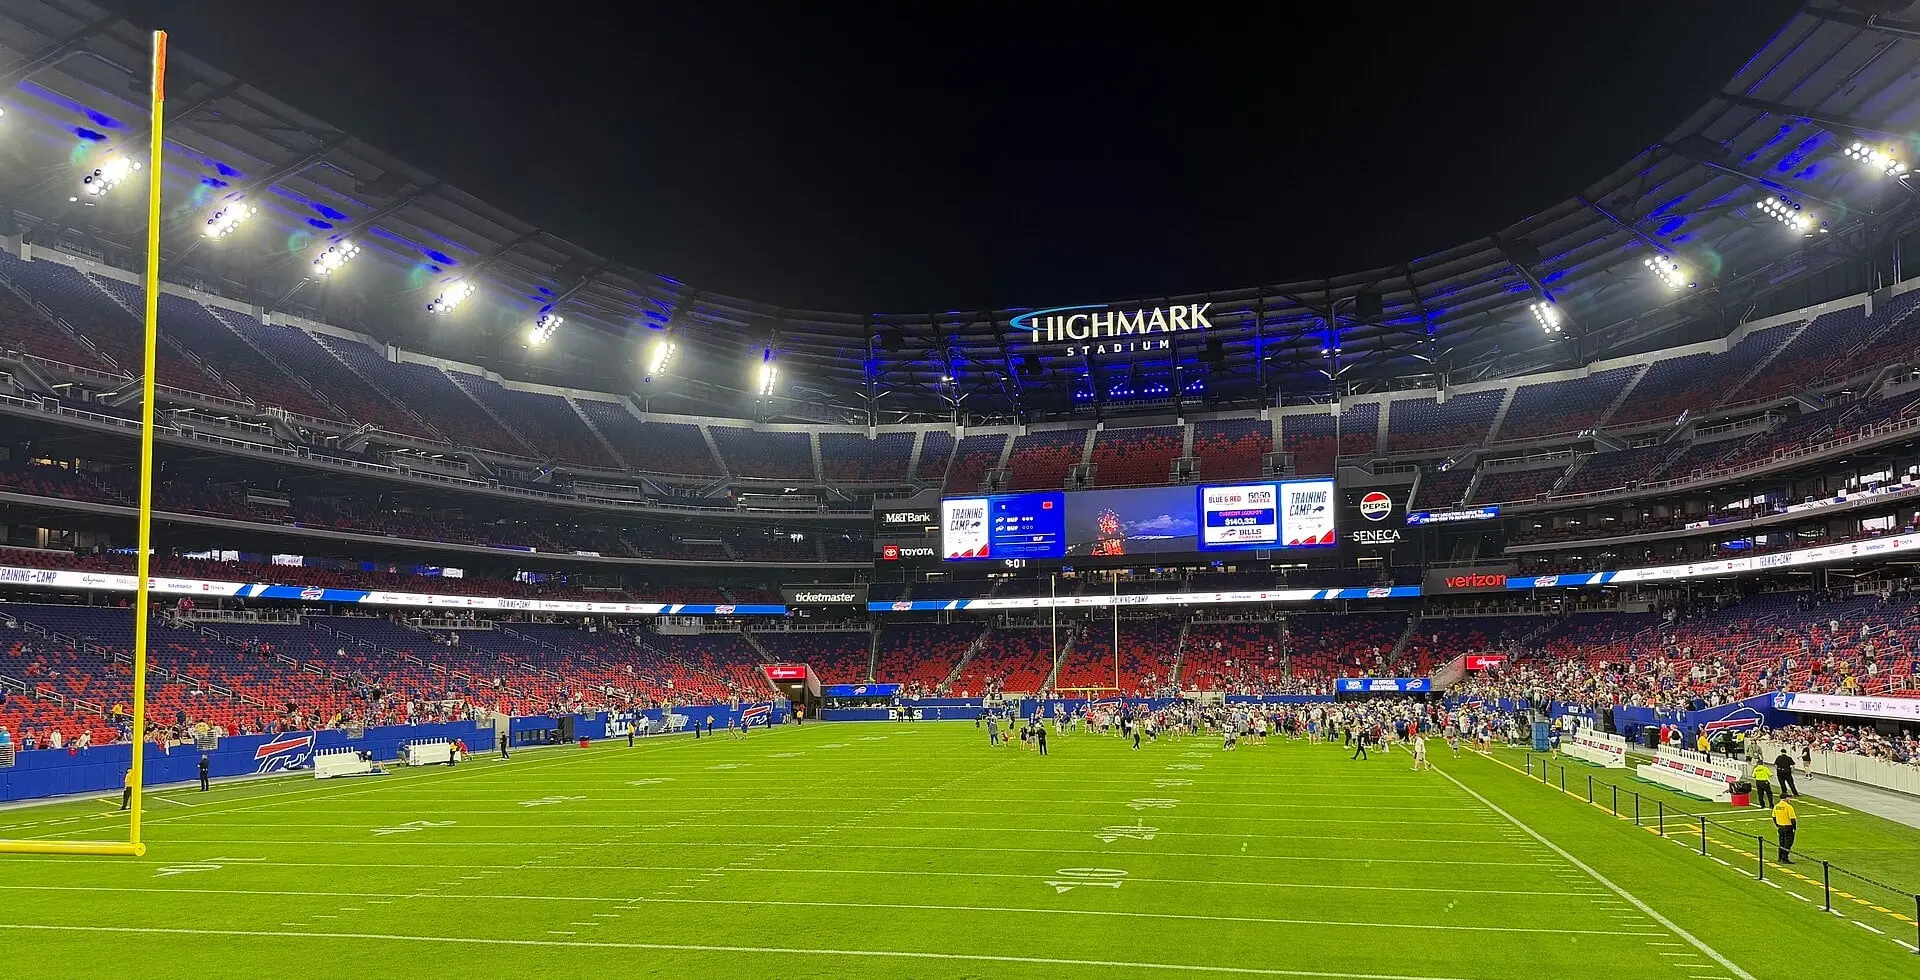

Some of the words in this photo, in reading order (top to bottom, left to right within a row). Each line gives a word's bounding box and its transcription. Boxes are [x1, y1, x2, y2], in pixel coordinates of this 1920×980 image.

[1031, 302, 1213, 343] HIGHMARK
[1066, 339, 1170, 357] STADIUM
[1208, 495, 1223, 504] BLUE
[1229, 495, 1242, 503] RED
[1290, 491, 1327, 504] TRAINING
[1289, 504, 1312, 517] CAMP
[1362, 502, 1390, 510] PEPSI
[885, 512, 908, 523] M&T
[907, 512, 931, 522] Bank
[951, 508, 984, 519] TRAINING
[950, 519, 970, 532] CAMP
[1239, 528, 1262, 536] BILLS
[1352, 529, 1401, 542] SENECA
[900, 548, 934, 557] TOYOTA
[36, 570, 57, 584] CAMP
[1445, 572, 1507, 588] verizon
[795, 592, 856, 602] ticketmaster
[1043, 868, 1129, 889] 10
